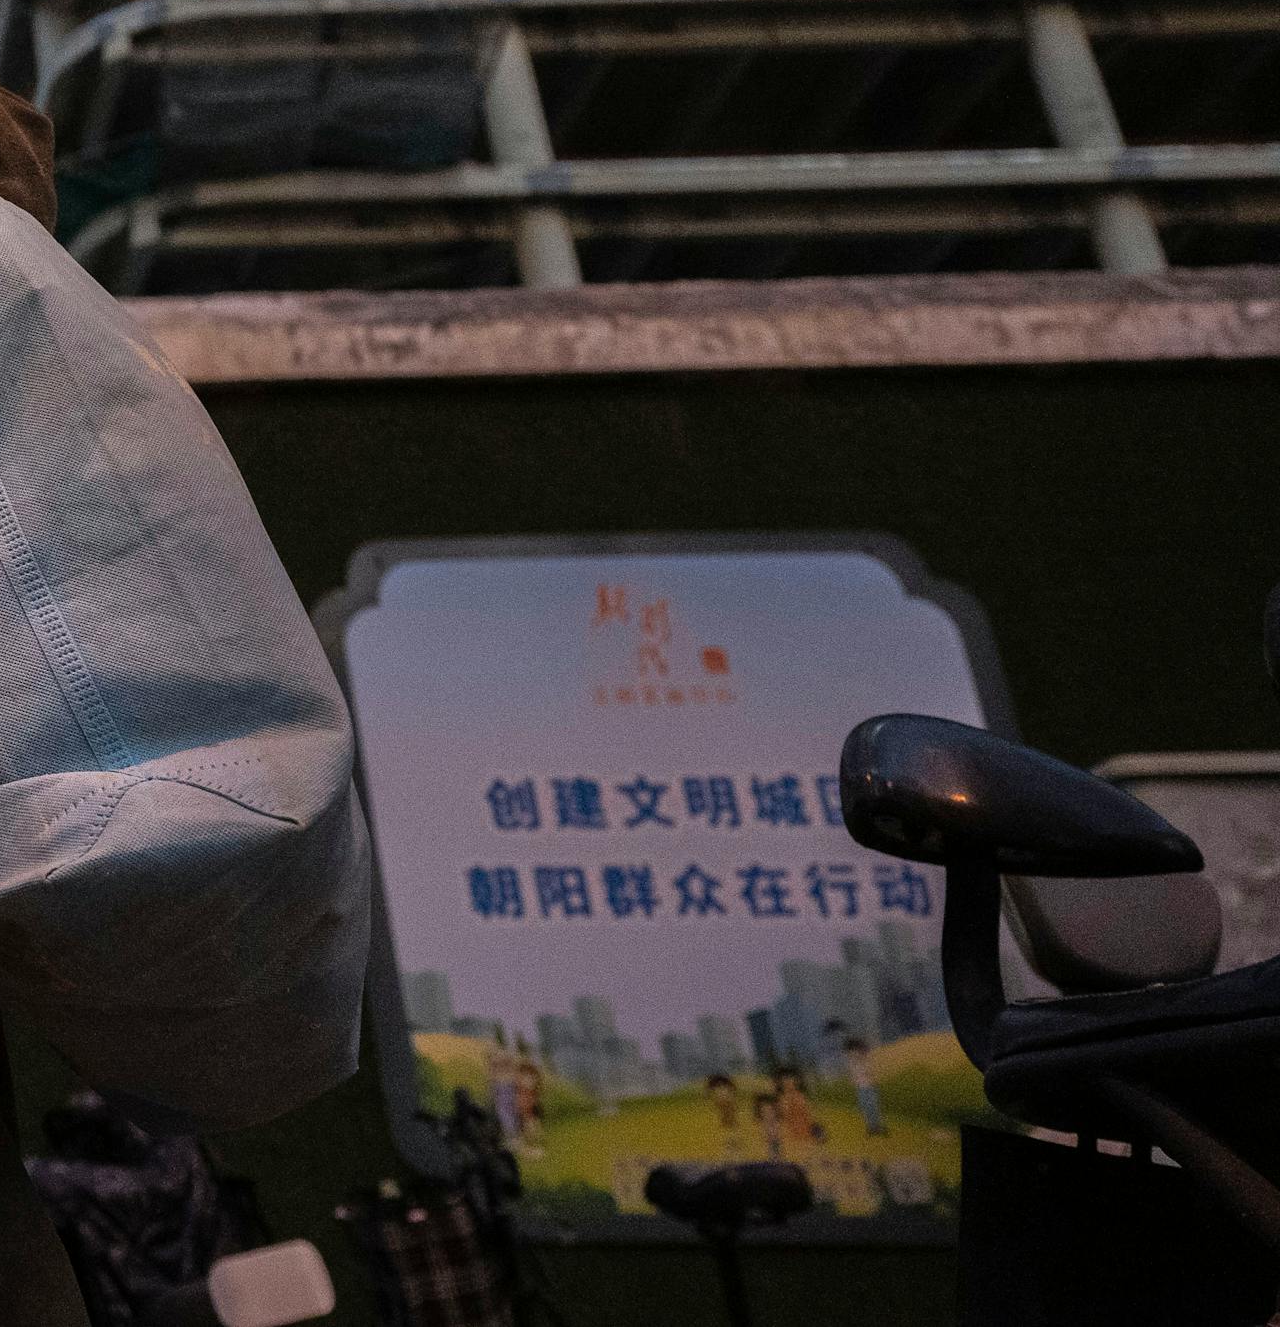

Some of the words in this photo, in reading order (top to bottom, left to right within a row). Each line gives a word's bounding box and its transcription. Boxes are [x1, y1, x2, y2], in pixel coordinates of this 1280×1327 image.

[468, 864, 932, 918] 朝阳群众在行动
